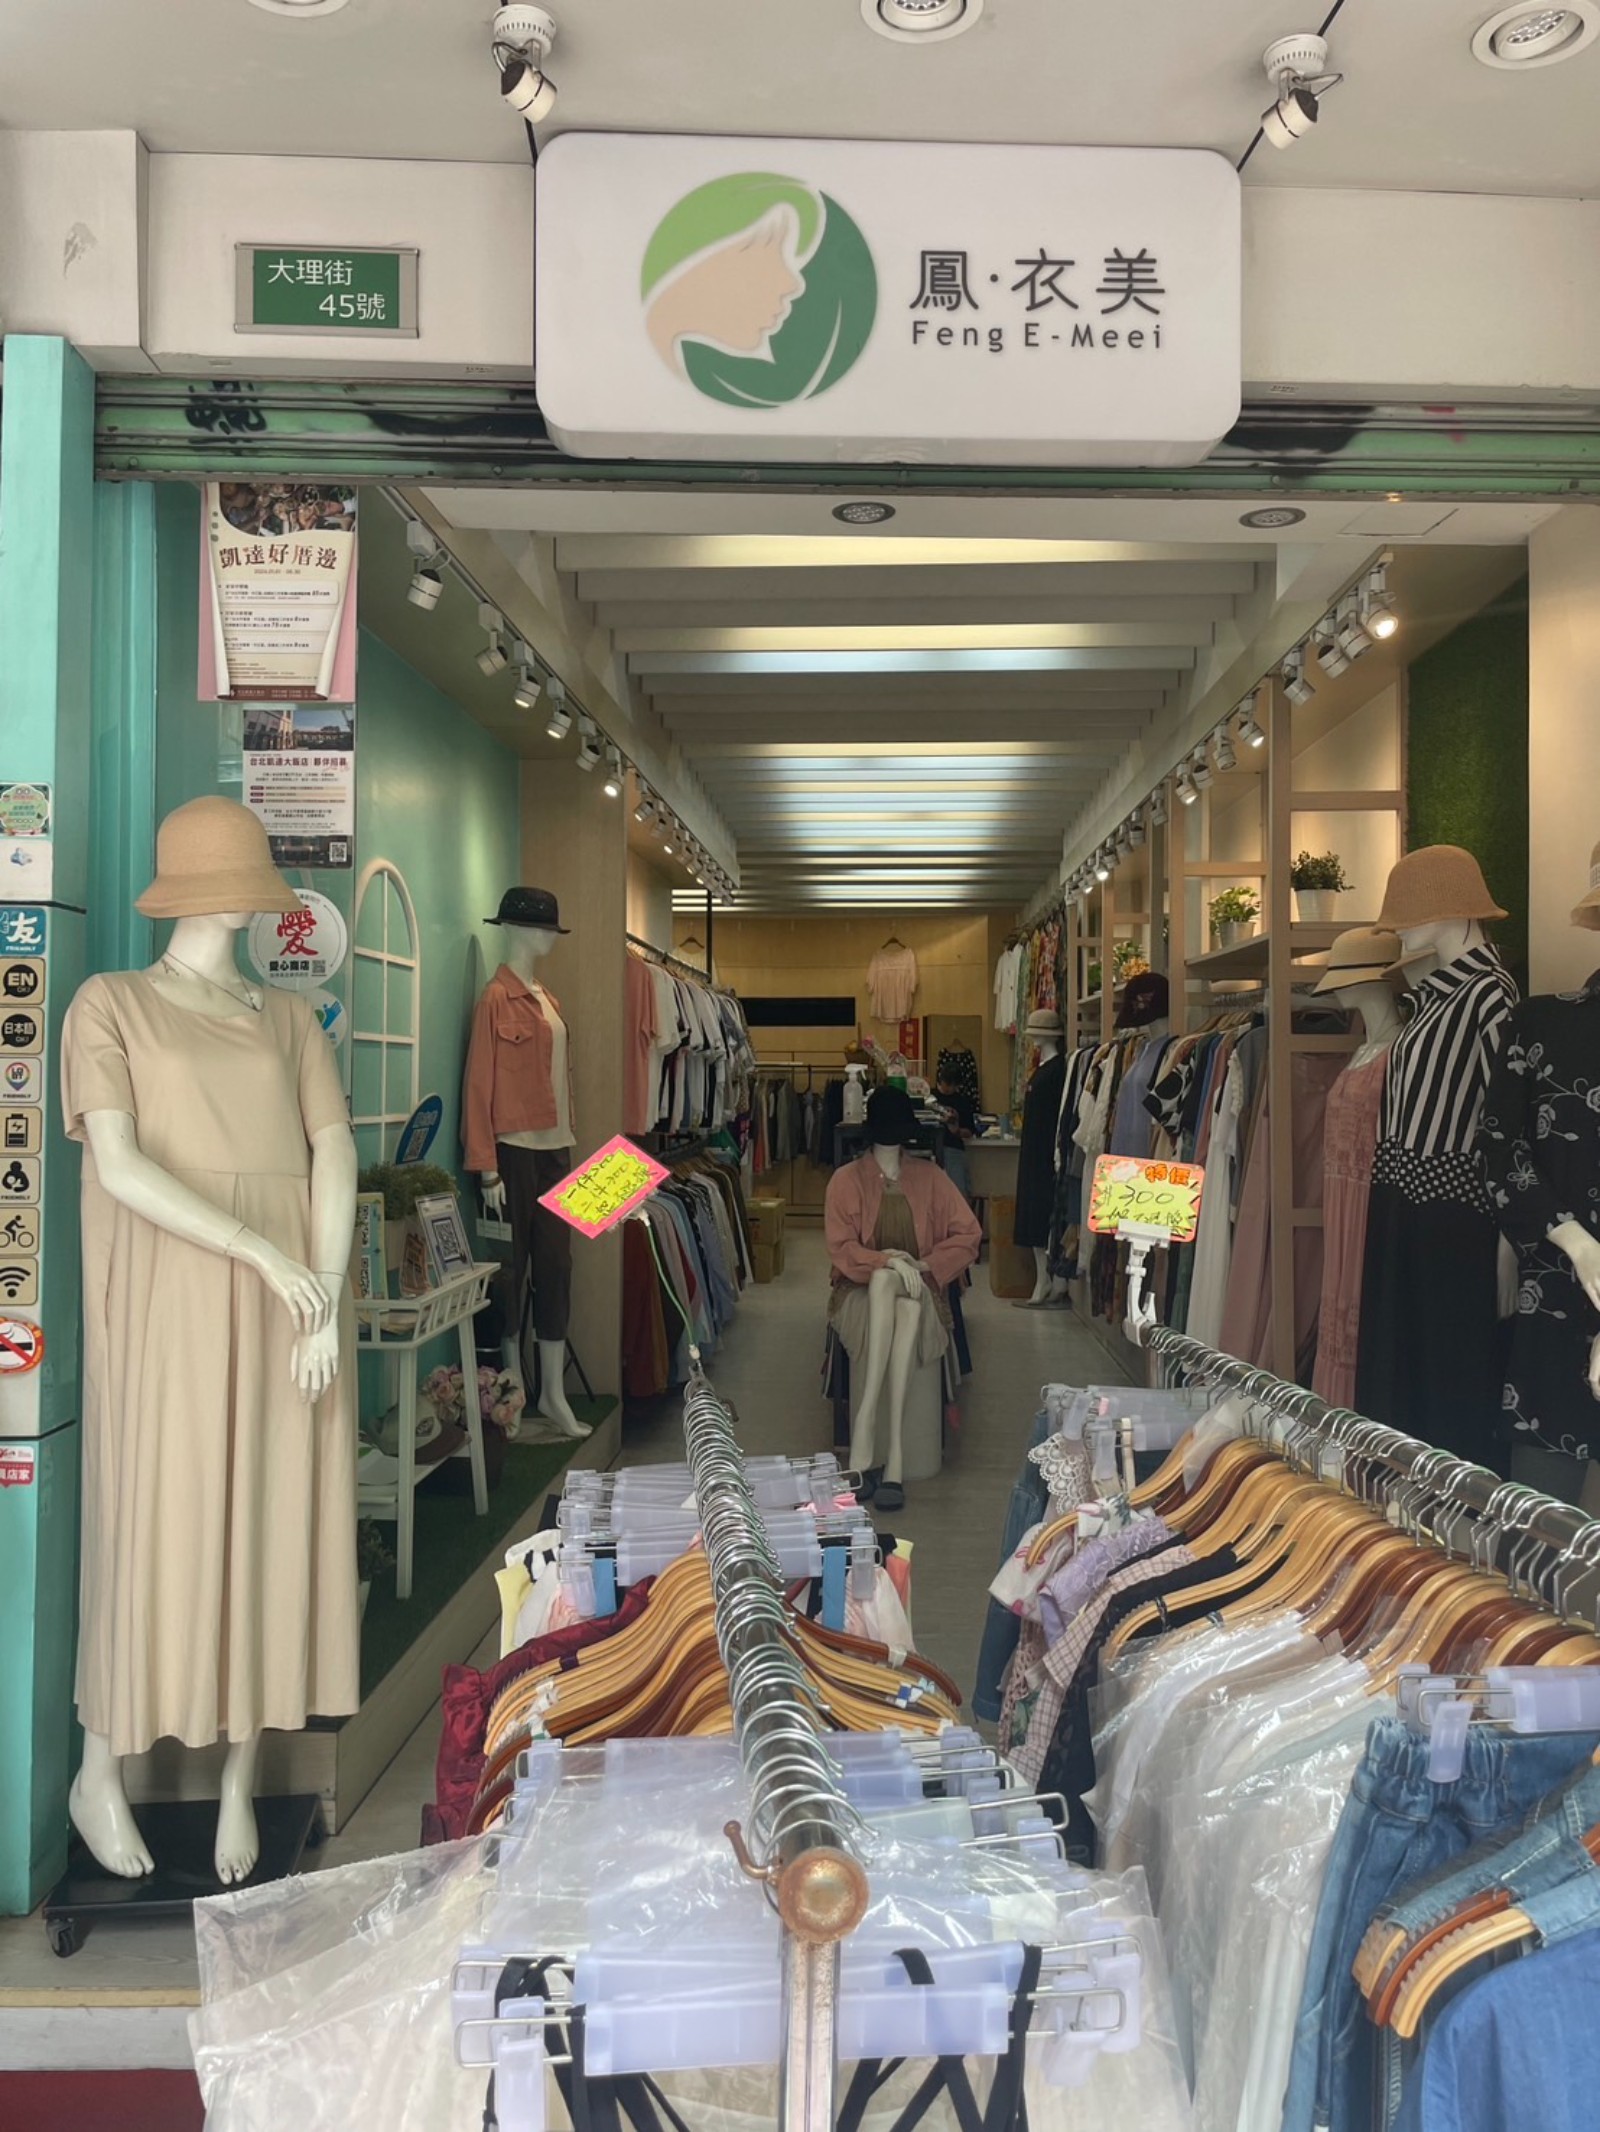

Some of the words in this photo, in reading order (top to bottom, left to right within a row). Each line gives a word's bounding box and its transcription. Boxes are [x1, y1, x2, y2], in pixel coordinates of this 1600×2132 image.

[267, 257, 353, 285] 大理街
[319, 293, 386, 321] 45號
[912, 320, 1004, 353] Feng
[1024, 322, 1162, 350] E-Meei
[218, 543, 338, 570] 凱達好厝邊
[5, 911, 42, 944] 友
[269, 959, 310, 971] 愛心商店
[8, 972, 34, 986] EN
[4, 1021, 34, 1035] 日本語
